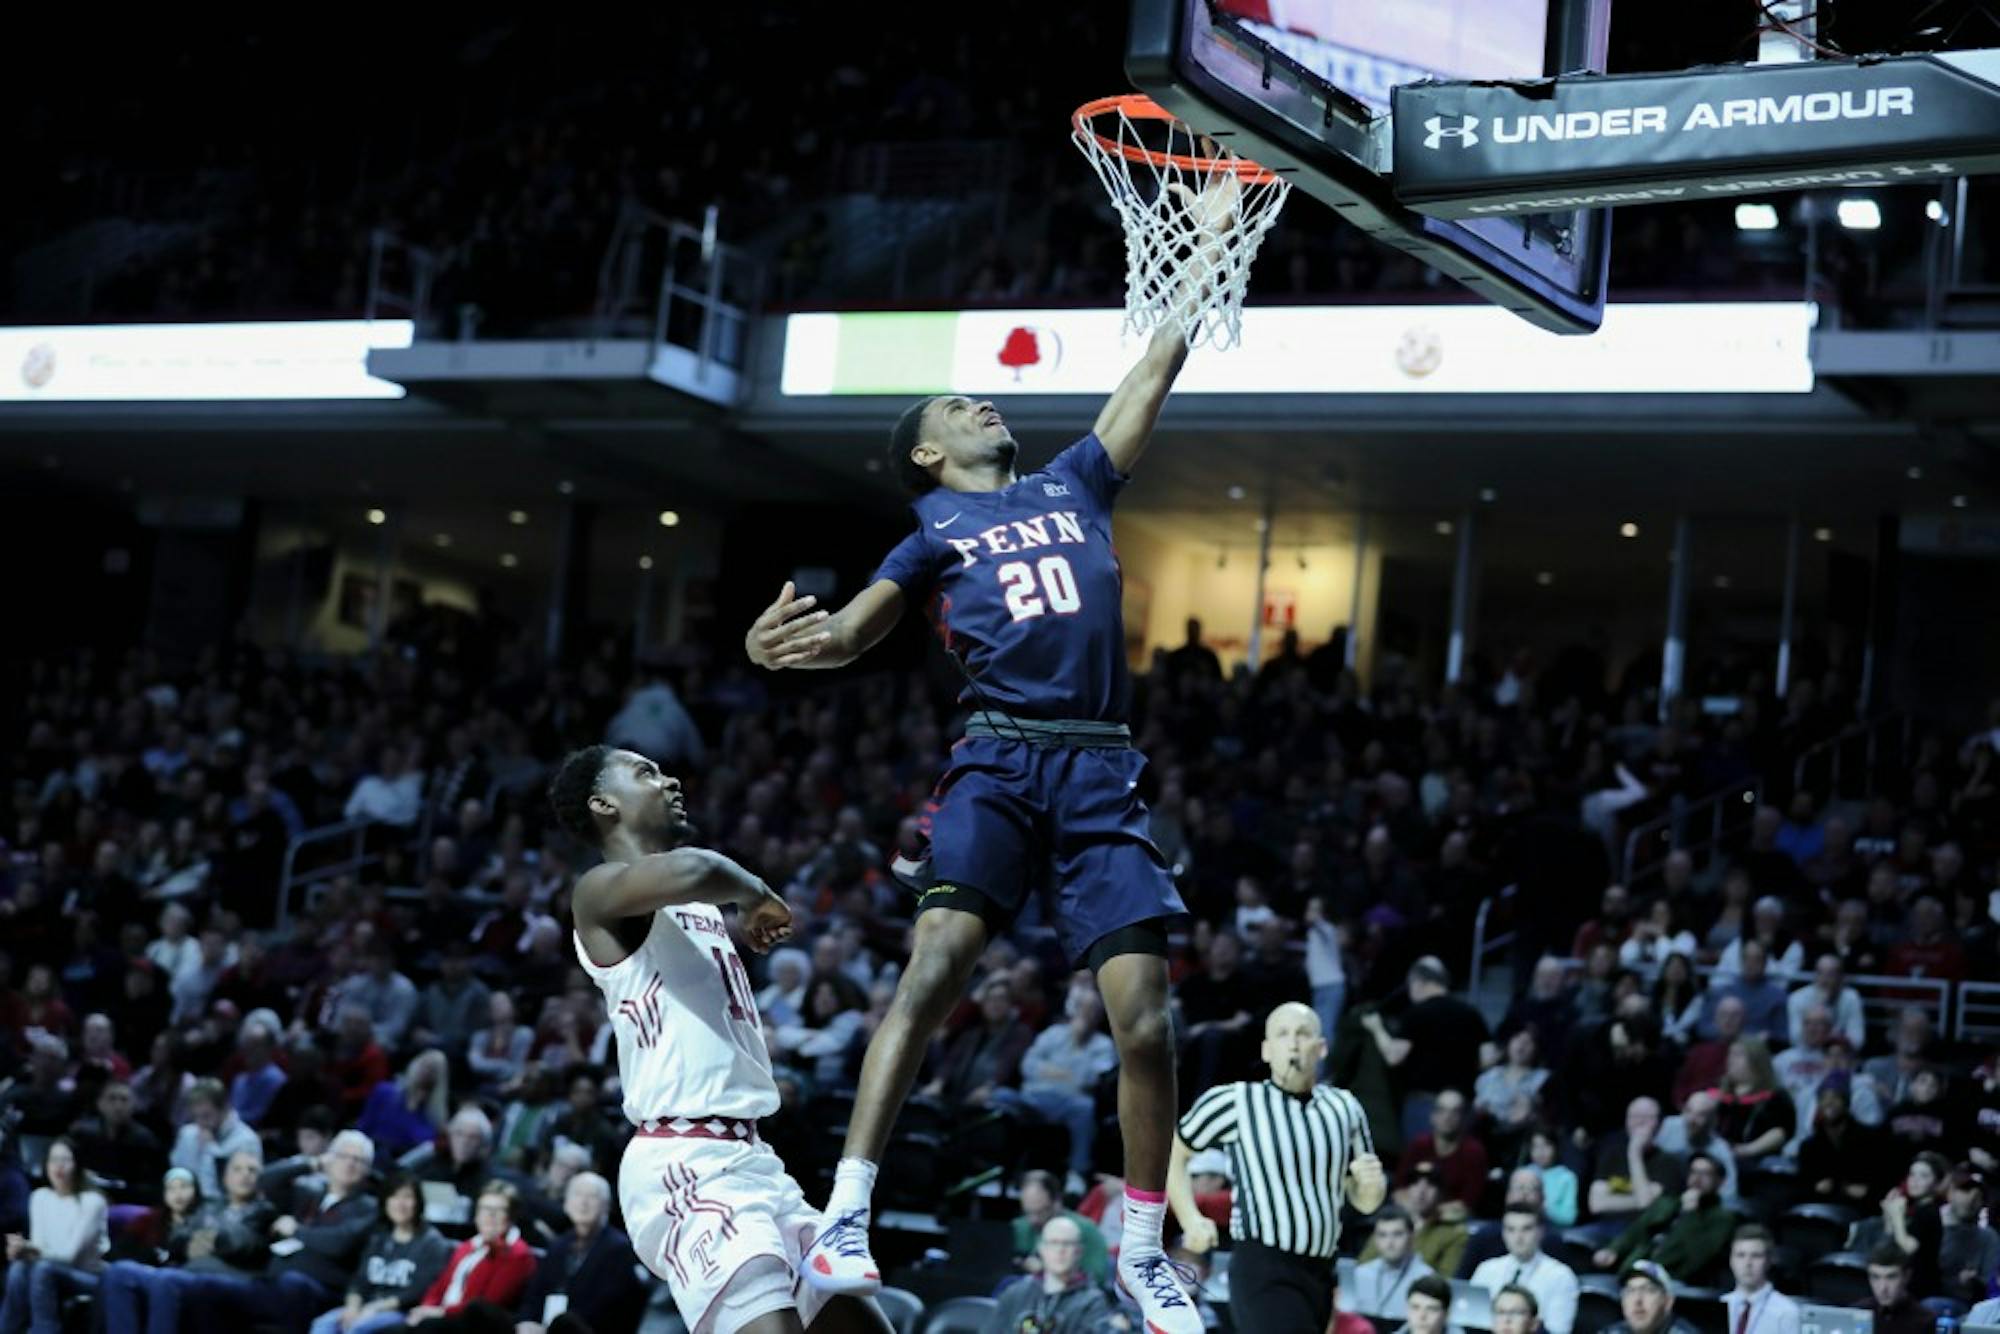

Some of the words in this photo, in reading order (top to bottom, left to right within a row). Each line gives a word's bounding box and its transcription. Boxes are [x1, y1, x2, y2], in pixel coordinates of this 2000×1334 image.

[1493, 106, 1667, 143] UNDER
[1682, 87, 1913, 131] ARMOUR
[947, 511, 1085, 568] PENN
[997, 555, 1081, 623] 20
